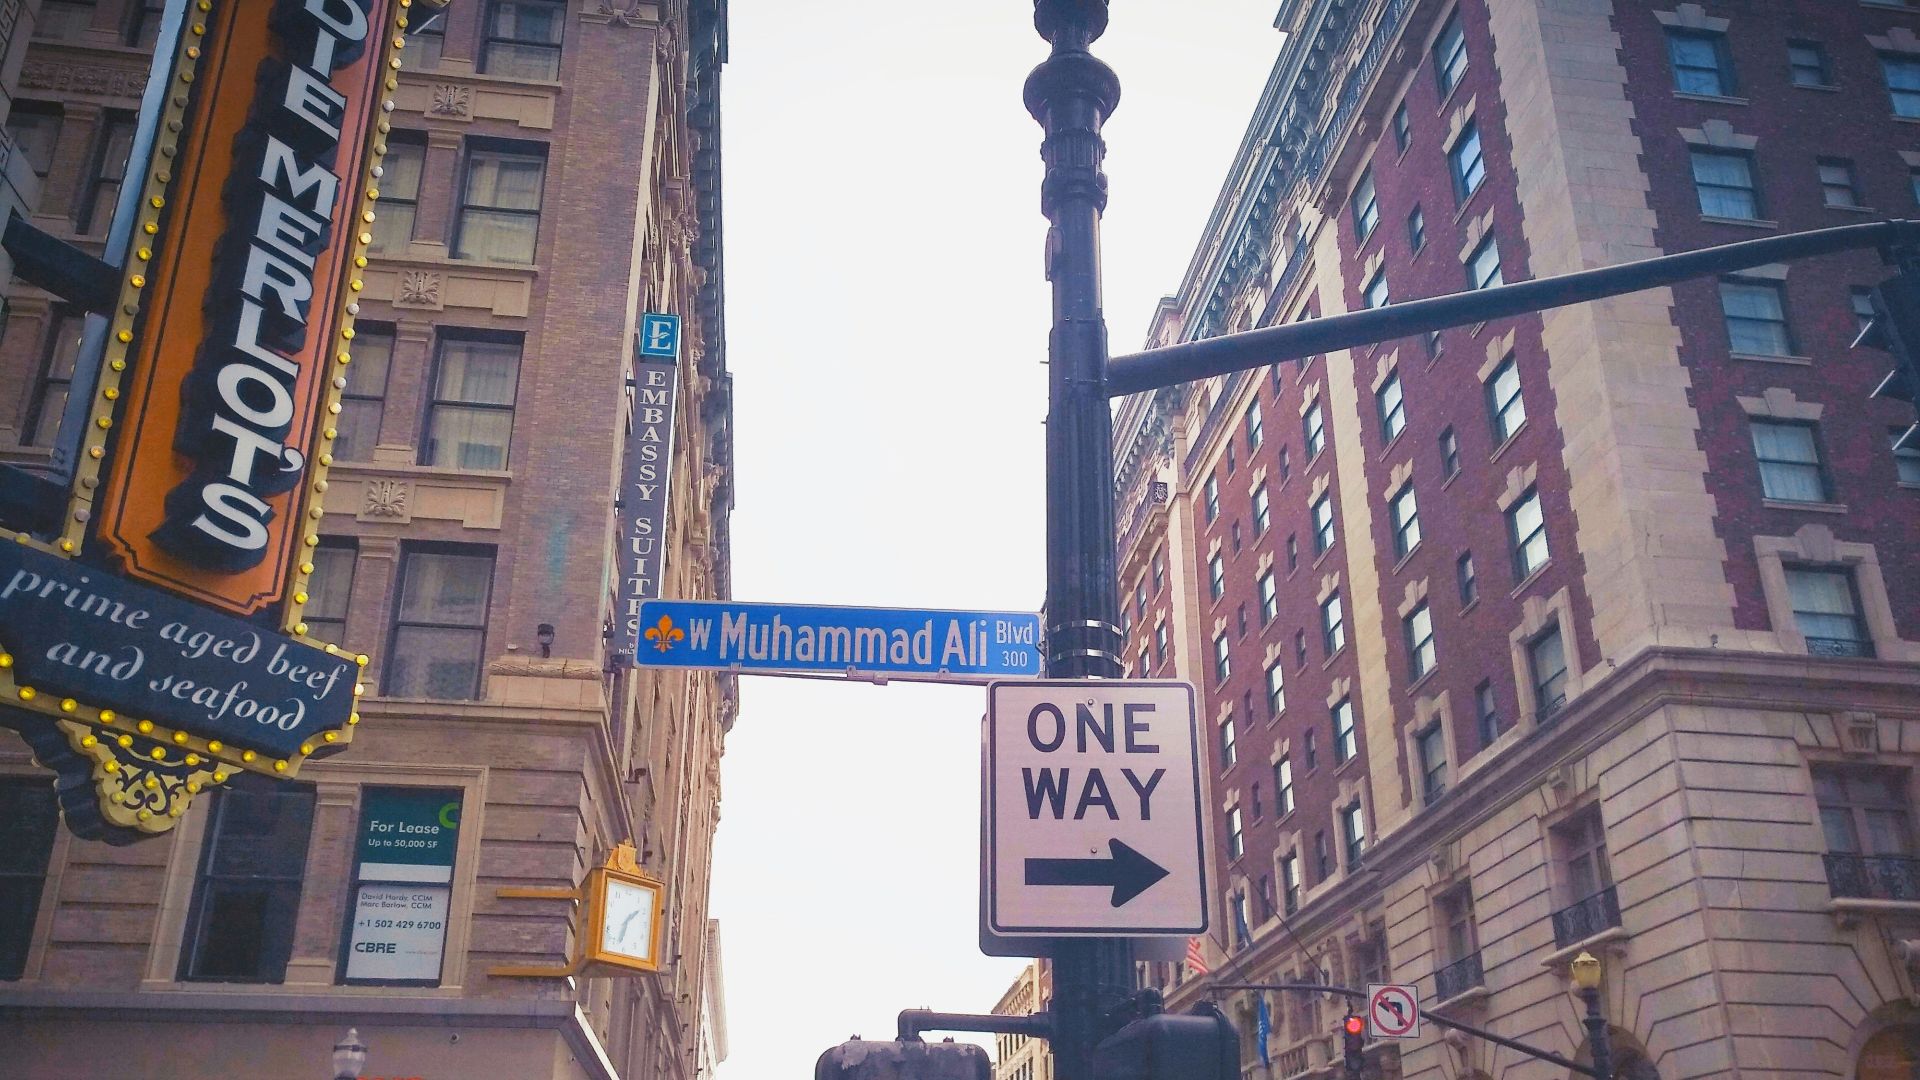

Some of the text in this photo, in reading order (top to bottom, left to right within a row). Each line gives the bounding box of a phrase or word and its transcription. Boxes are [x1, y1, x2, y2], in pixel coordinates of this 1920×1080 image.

[192, 135, 341, 550] MERLOT'S
[635, 370, 669, 501] EMBASSY
[1, 568, 348, 700] prime aged beef
[689, 611, 1033, 667] W Muhammad Ali Blvd
[1001, 650, 1028, 667] 300
[46, 641, 306, 731] and seafood
[1027, 702, 1160, 754] ONE
[1021, 767, 1167, 821] WAY
[368, 838, 438, 849] Up to 50,000 SF
[369, 820, 440, 835] For Lease
[354, 942, 397, 954] CBRE
[358, 919, 442, 930] +1 502 429 6700
